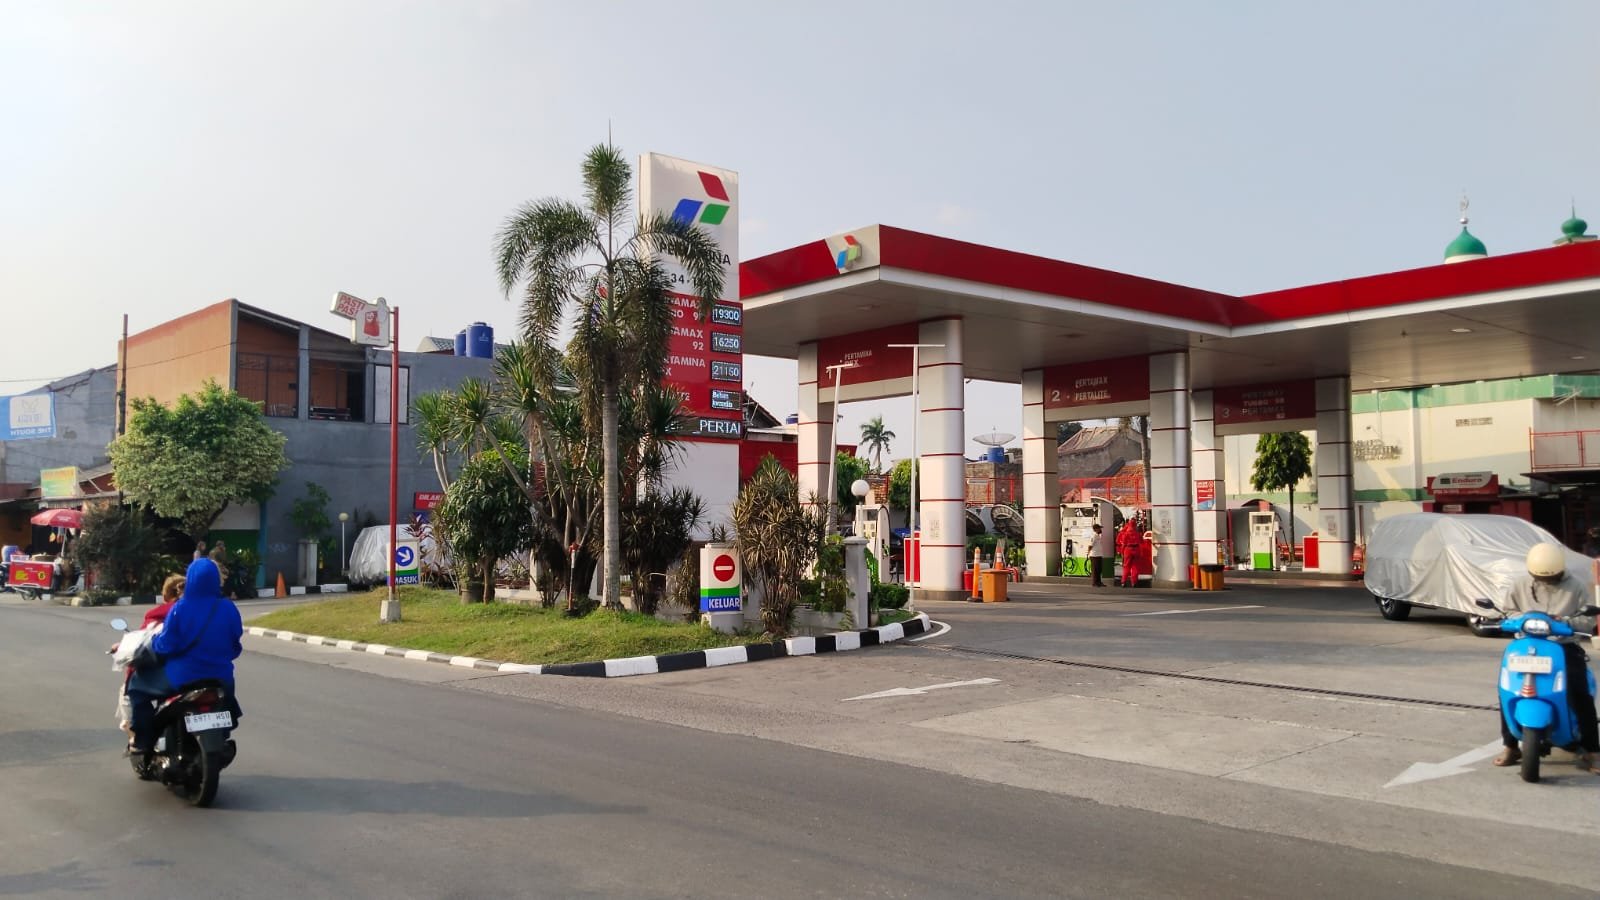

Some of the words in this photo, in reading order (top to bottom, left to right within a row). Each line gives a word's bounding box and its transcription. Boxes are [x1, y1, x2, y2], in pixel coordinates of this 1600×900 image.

[714, 308, 740, 321] 19300
[692, 341, 704, 351] 92
[714, 336, 739, 348] 16250
[844, 350, 872, 360] PERTAMINA
[713, 365, 739, 377] 21150
[1052, 390, 1060, 402] 2
[1223, 407, 1231, 418] 3
[708, 597, 740, 609] KELUAR
